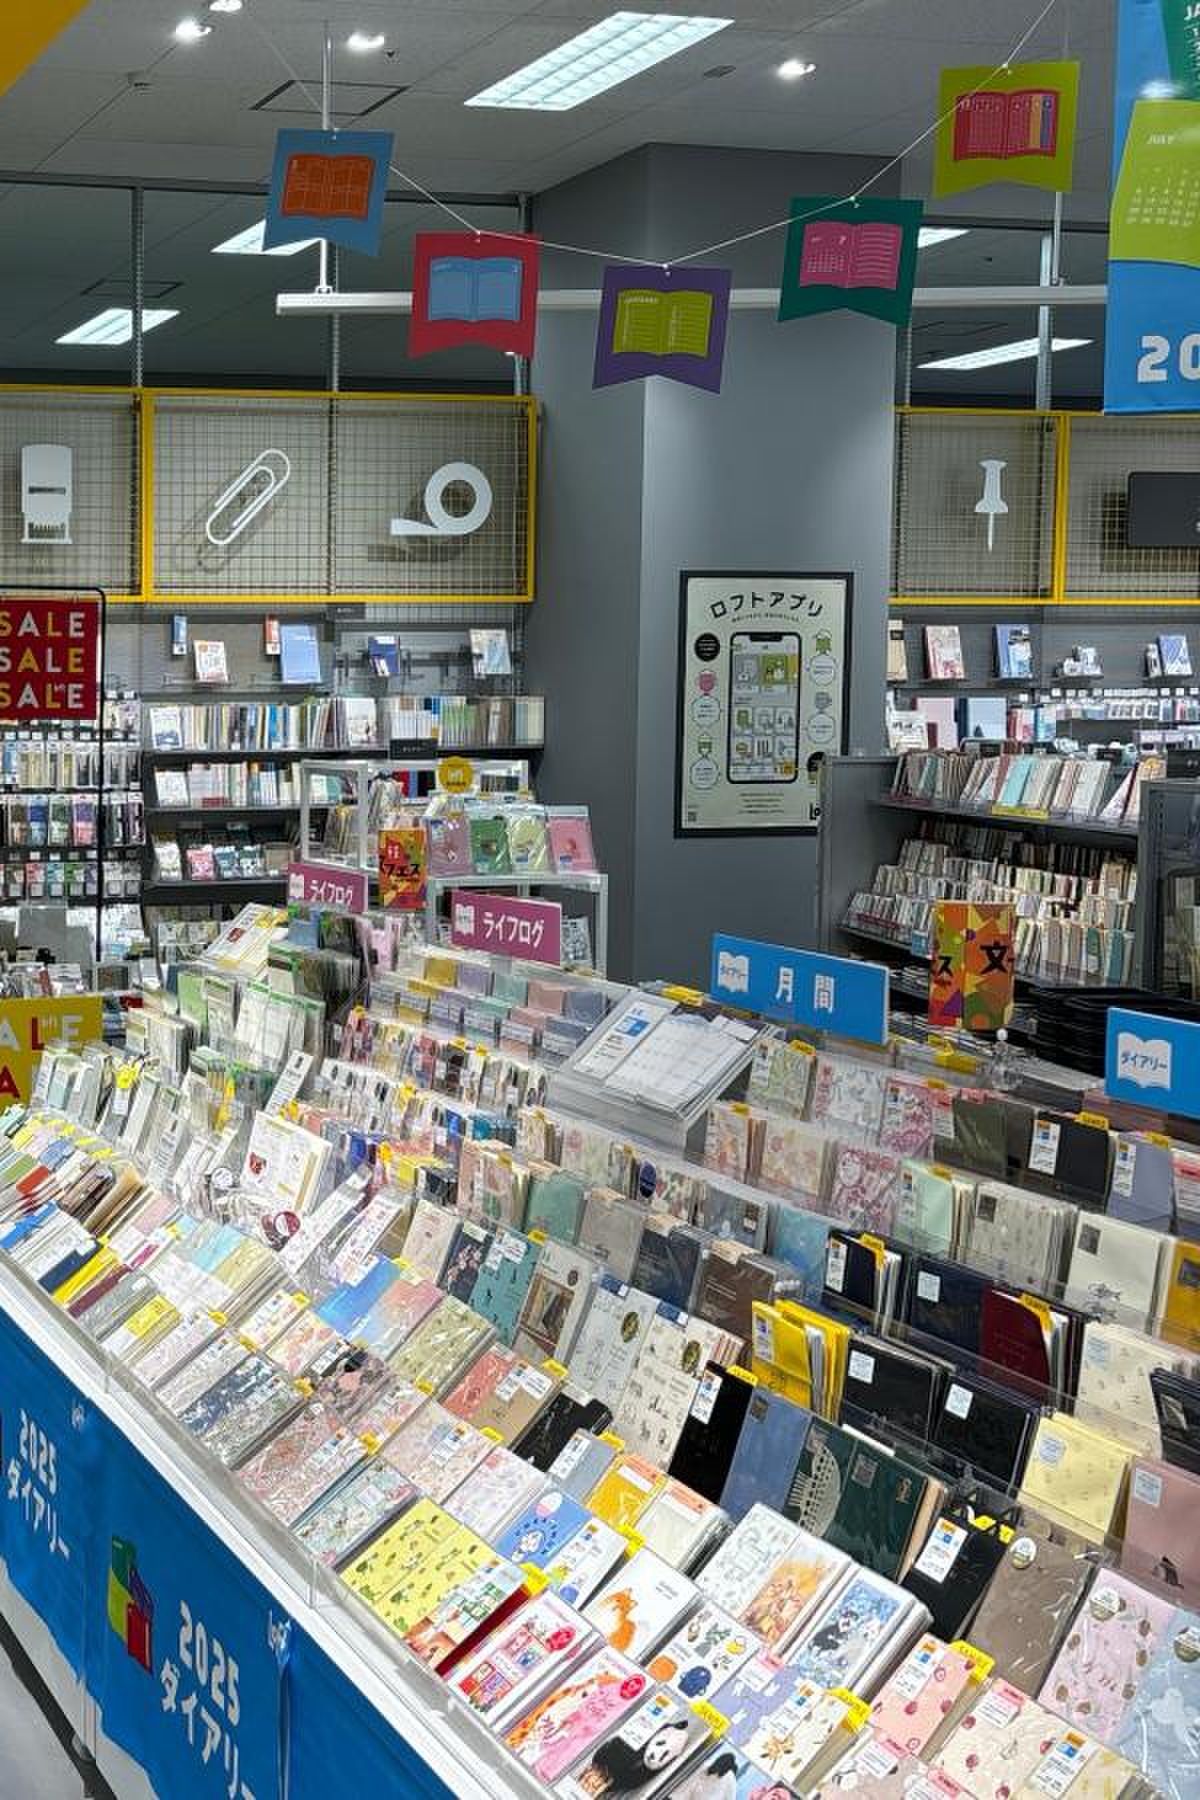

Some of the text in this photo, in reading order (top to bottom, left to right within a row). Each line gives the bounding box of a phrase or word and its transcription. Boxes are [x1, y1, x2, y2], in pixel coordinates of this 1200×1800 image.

[710, 590, 823, 618] ロフトアプリ
[309, 879, 353, 907] ライフログ
[483, 911, 545, 949] ライフログ
[1120, 1050, 1169, 1072] ダイアリー
[20, 1408, 57, 1496] 2025
[8, 1456, 70, 1561] ダイアリー
[180, 1599, 240, 1728] 2025
[160, 1657, 257, 1800] ダイアリー
